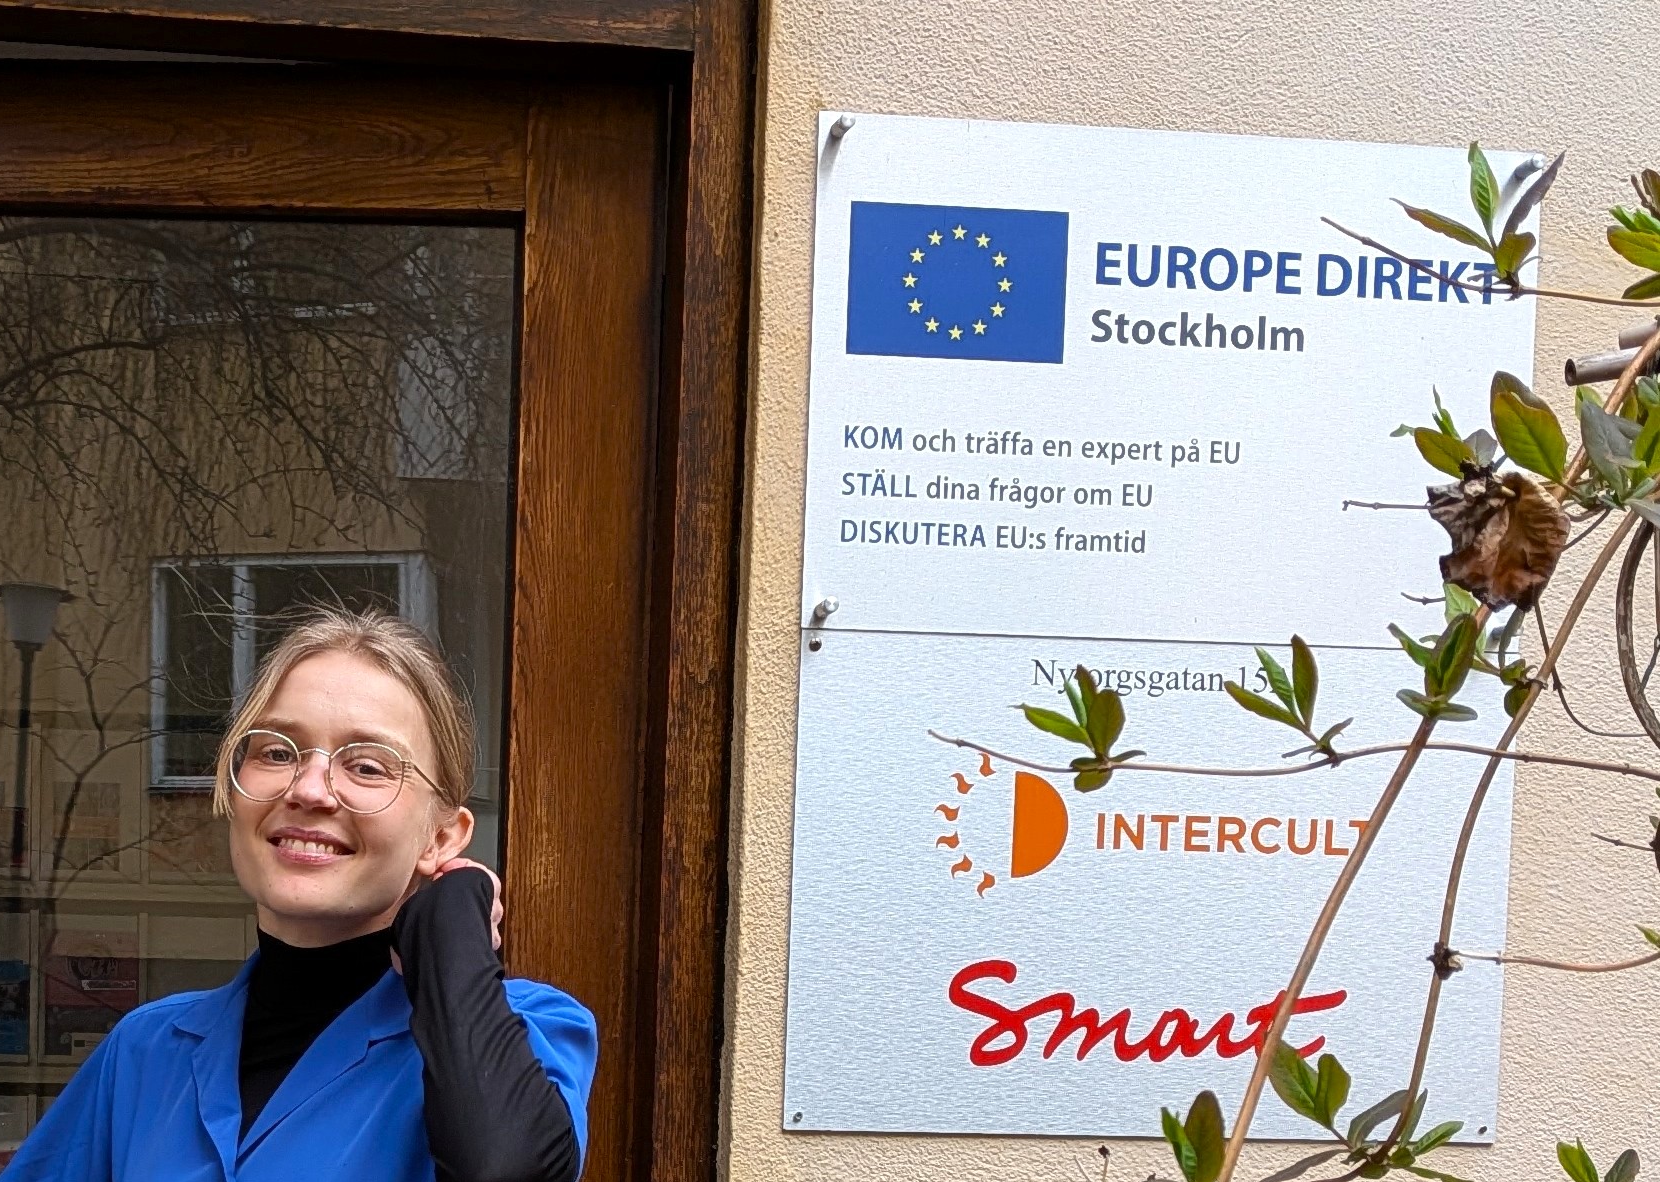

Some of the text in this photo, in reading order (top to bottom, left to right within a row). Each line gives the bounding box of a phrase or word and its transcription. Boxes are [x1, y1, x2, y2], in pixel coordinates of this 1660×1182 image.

[1095, 241, 1497, 305] EUROPE DIREKT
[1090, 308, 1305, 353] Stockholm
[843, 424, 1241, 468] KOM och träffa en expert på EU
[841, 467, 1154, 510] STÄLL dina frågor om EU
[840, 518, 1147, 554] DISKUTERA EU:s framtid
[1030, 658, 1225, 698] Nyorgsgatan
[947, 958, 1348, 1067] Smart
